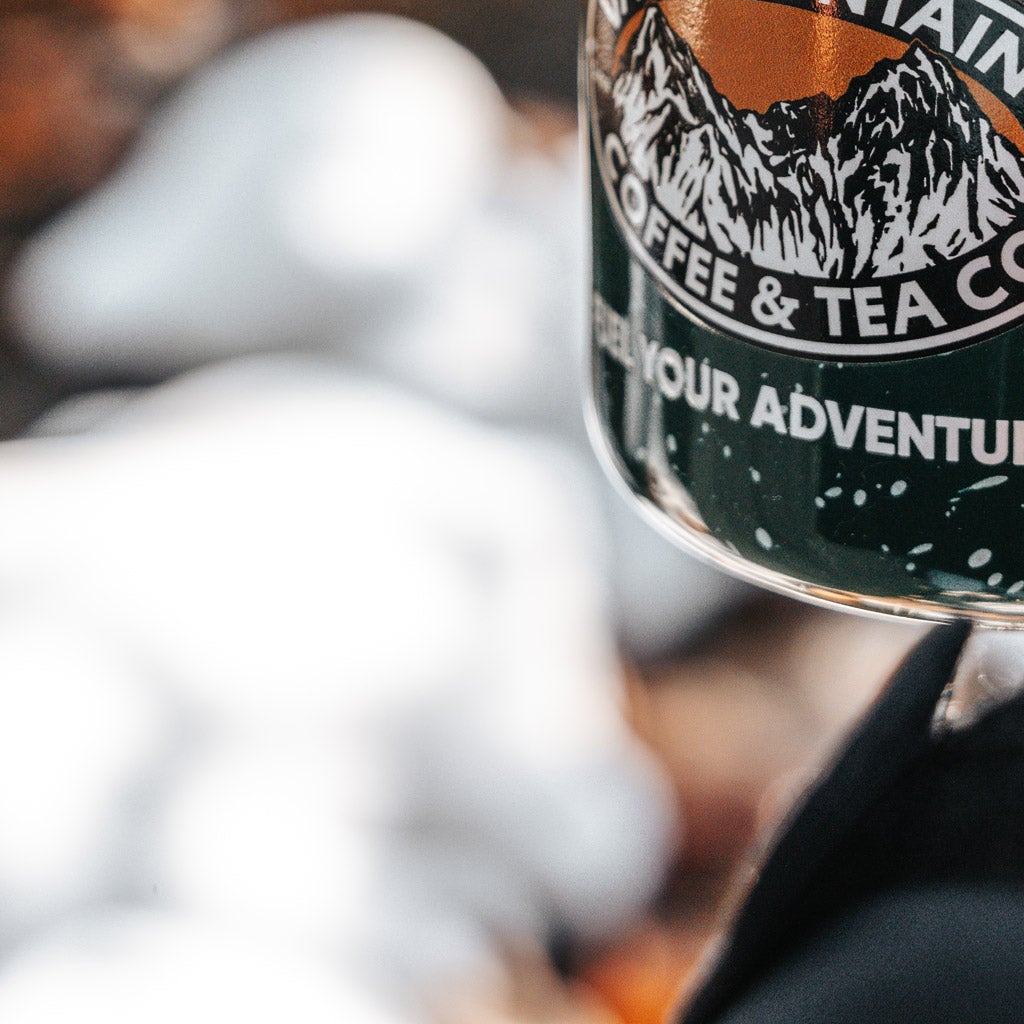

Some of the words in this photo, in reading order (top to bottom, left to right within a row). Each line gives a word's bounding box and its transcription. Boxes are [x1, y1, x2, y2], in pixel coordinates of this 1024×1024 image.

[604, 133, 739, 312] COFFEE
[751, 276, 800, 331] &
[814, 280, 948, 338] TEA
[638, 332, 741, 421] YOUR
